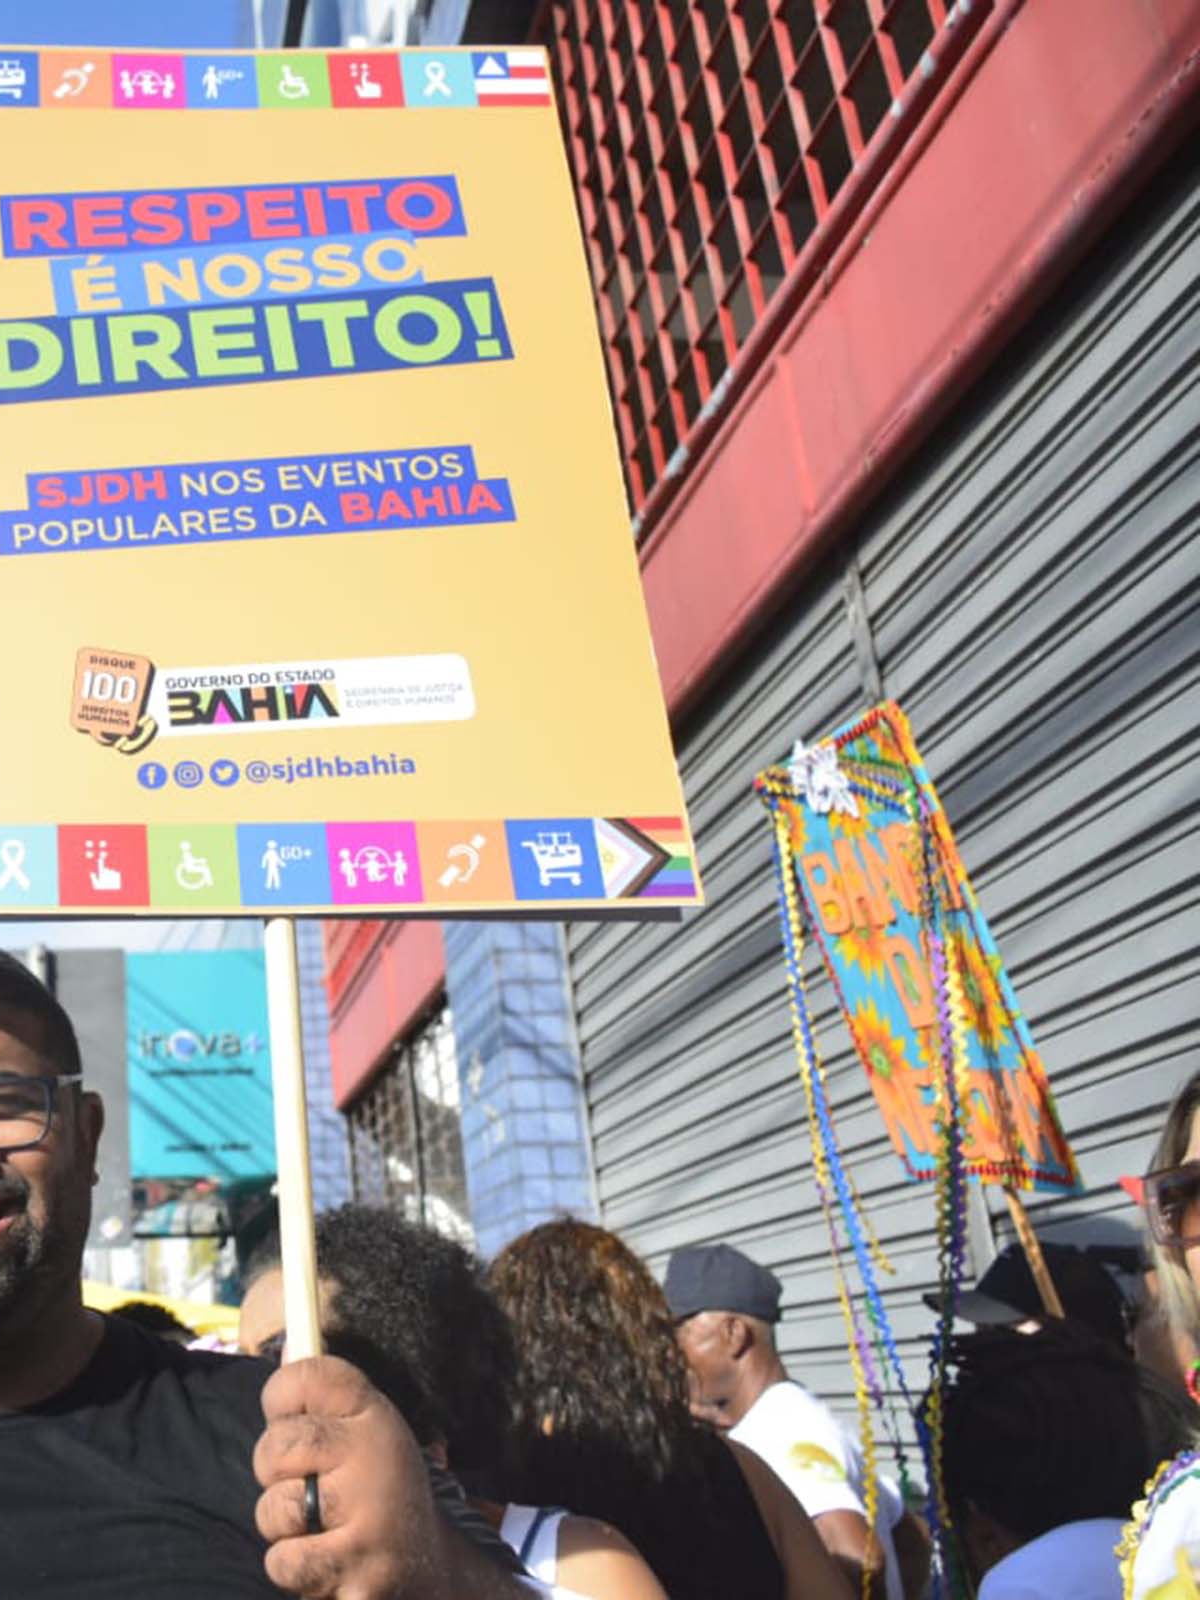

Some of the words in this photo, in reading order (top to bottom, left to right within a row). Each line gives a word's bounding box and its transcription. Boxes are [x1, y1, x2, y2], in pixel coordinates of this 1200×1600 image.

[11, 181, 453, 250] RESPEITO
[71, 253, 123, 313] É
[141, 237, 425, 306] NOSSO
[36, 469, 169, 509] SJDH
[180, 467, 266, 498] NOS
[277, 453, 465, 491] EVENTOS
[12, 506, 258, 549] POPULARES
[269, 501, 328, 530] DA
[339, 482, 504, 524] BAHIA
[89, 655, 136, 669] DISQUE
[165, 674, 244, 690] GOVERNO
[248, 672, 271, 685] DO
[275, 668, 336, 684] ESTADO
[82, 670, 138, 704] 100
[245, 752, 417, 784] @sjdhbahia
